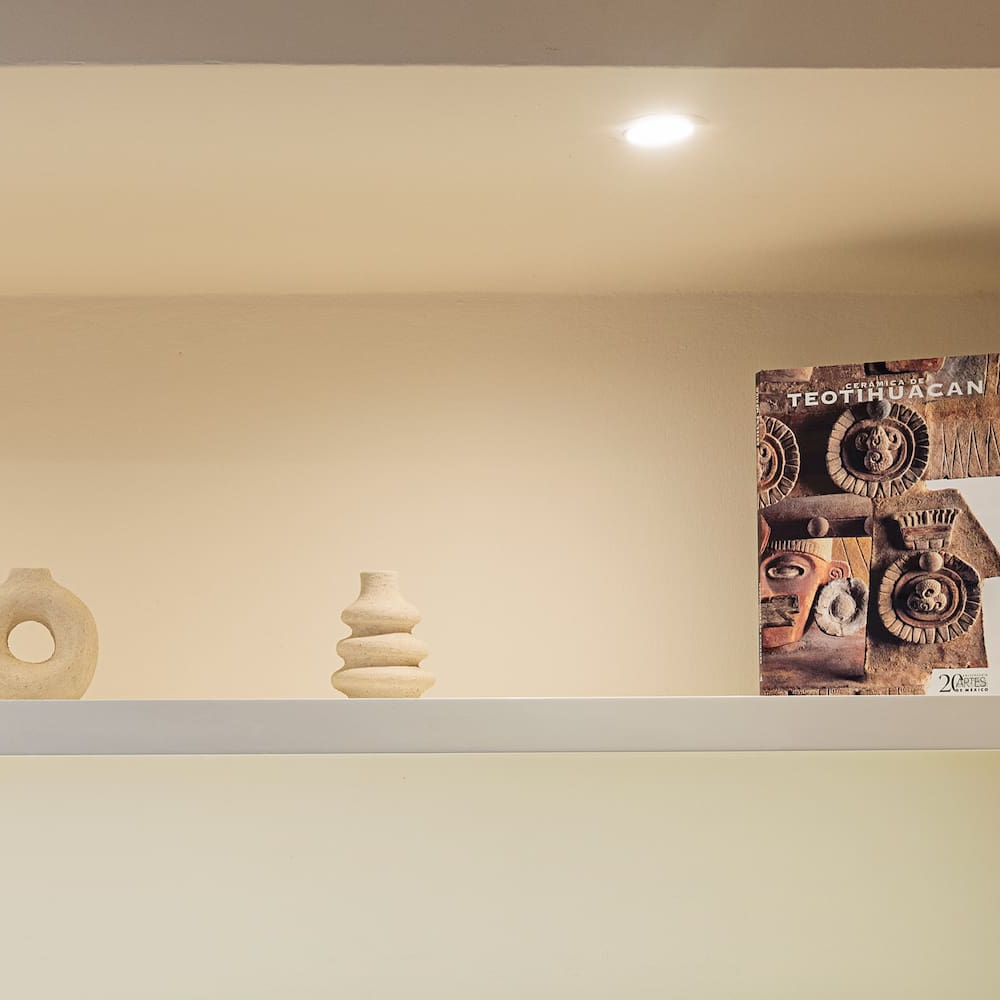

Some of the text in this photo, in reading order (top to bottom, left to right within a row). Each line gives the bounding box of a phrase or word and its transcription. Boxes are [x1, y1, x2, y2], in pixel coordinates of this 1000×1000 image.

[910, 377, 925, 385] DE
[787, 380, 985, 408] TEOTIHUACAN
[939, 674, 964, 693] 20
[956, 676, 987, 688] ARTES
